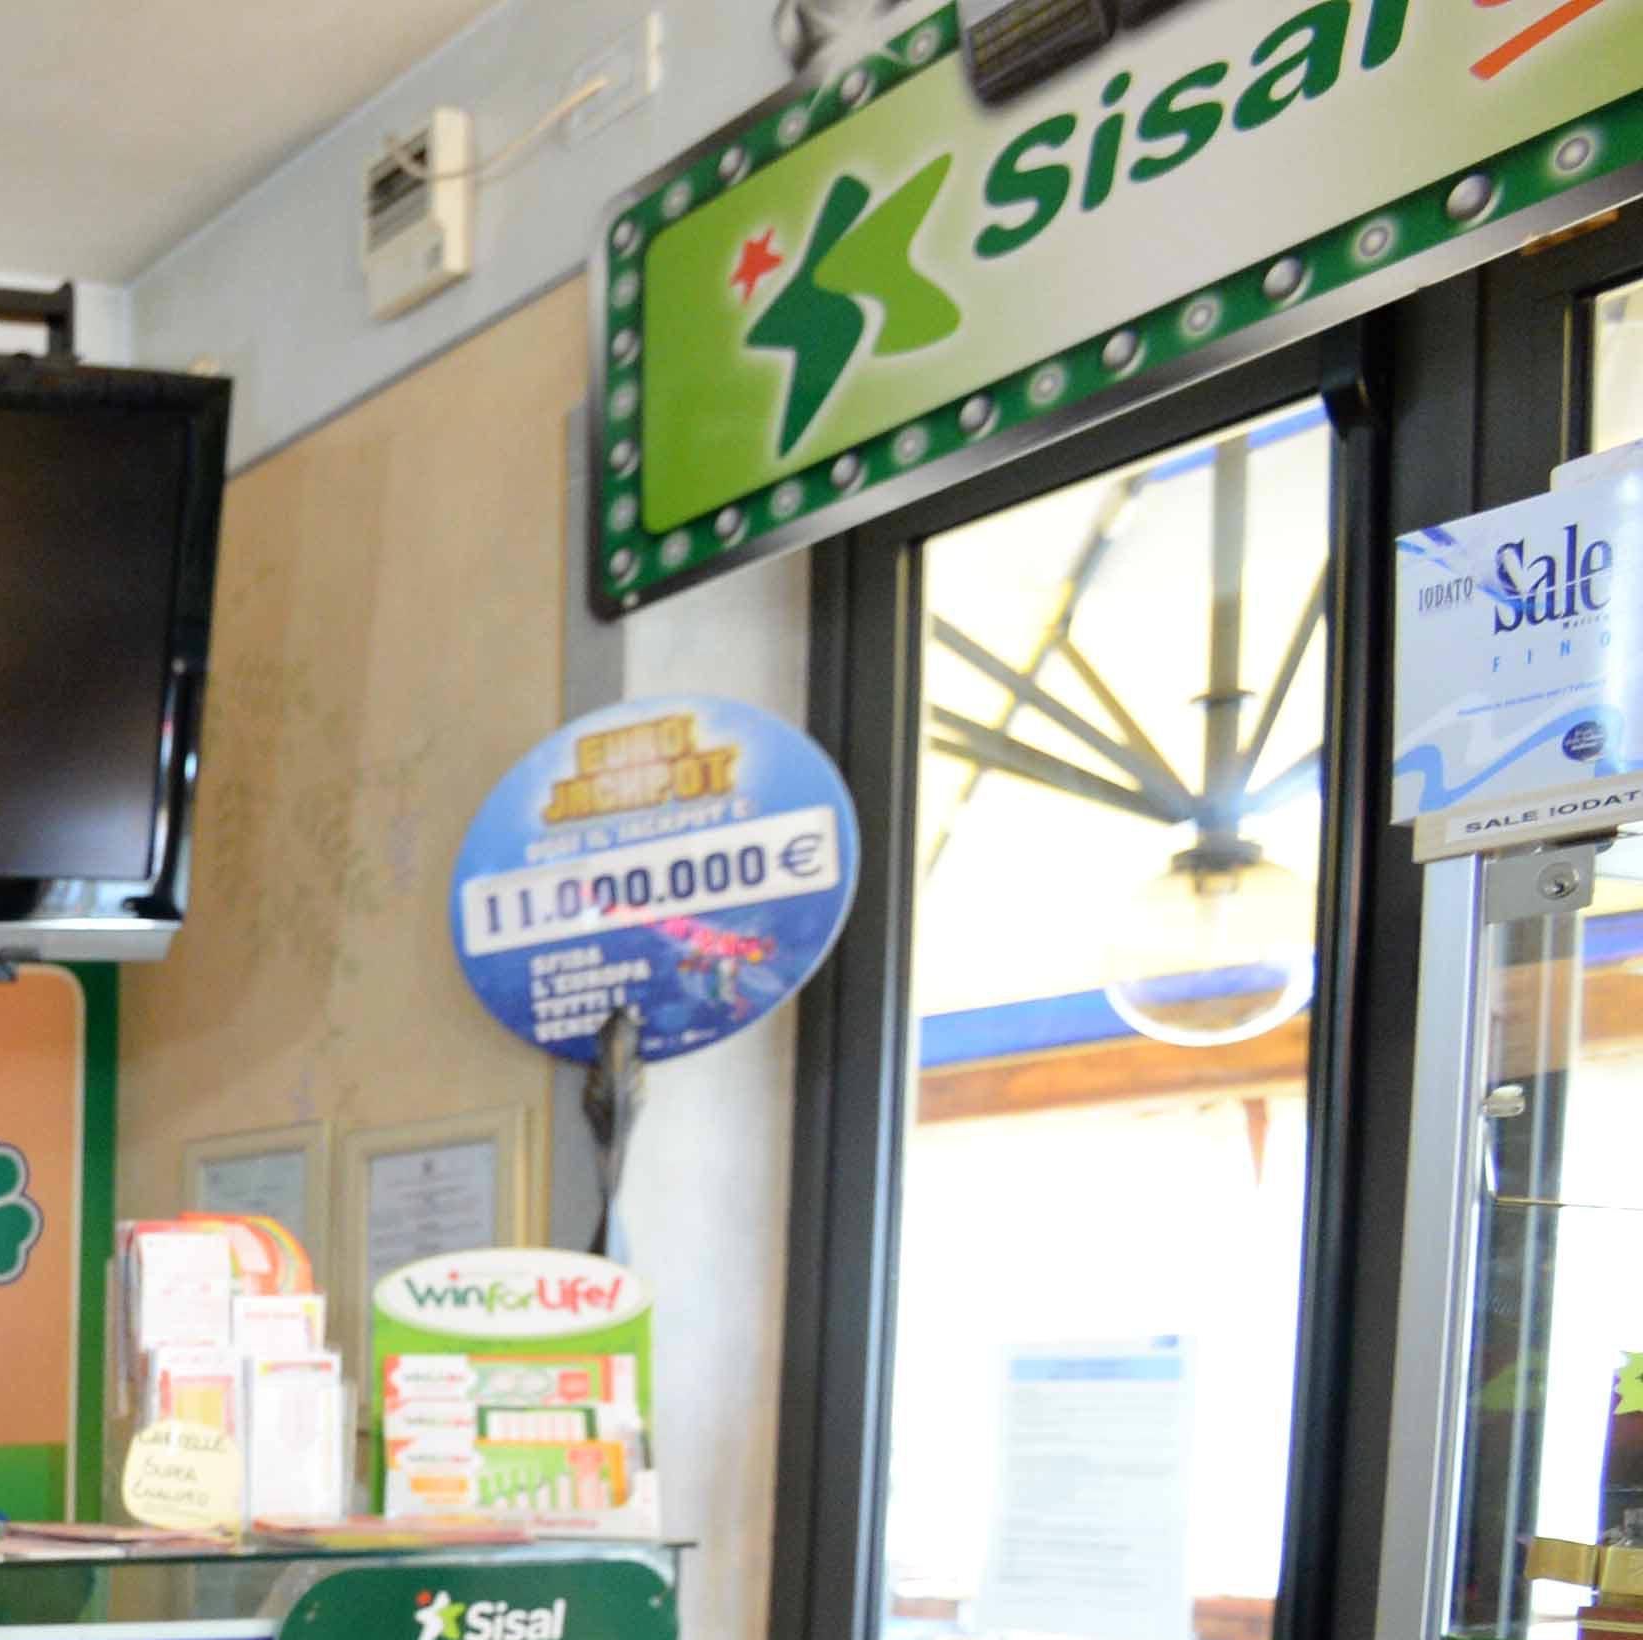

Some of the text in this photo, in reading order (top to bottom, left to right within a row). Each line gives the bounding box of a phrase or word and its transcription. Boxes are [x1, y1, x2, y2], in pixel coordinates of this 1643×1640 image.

[974, 0, 1411, 260] Sisal
[1418, 524, 1613, 635] IODATO Sale
[1464, 790, 1643, 834] SALE IODAT
